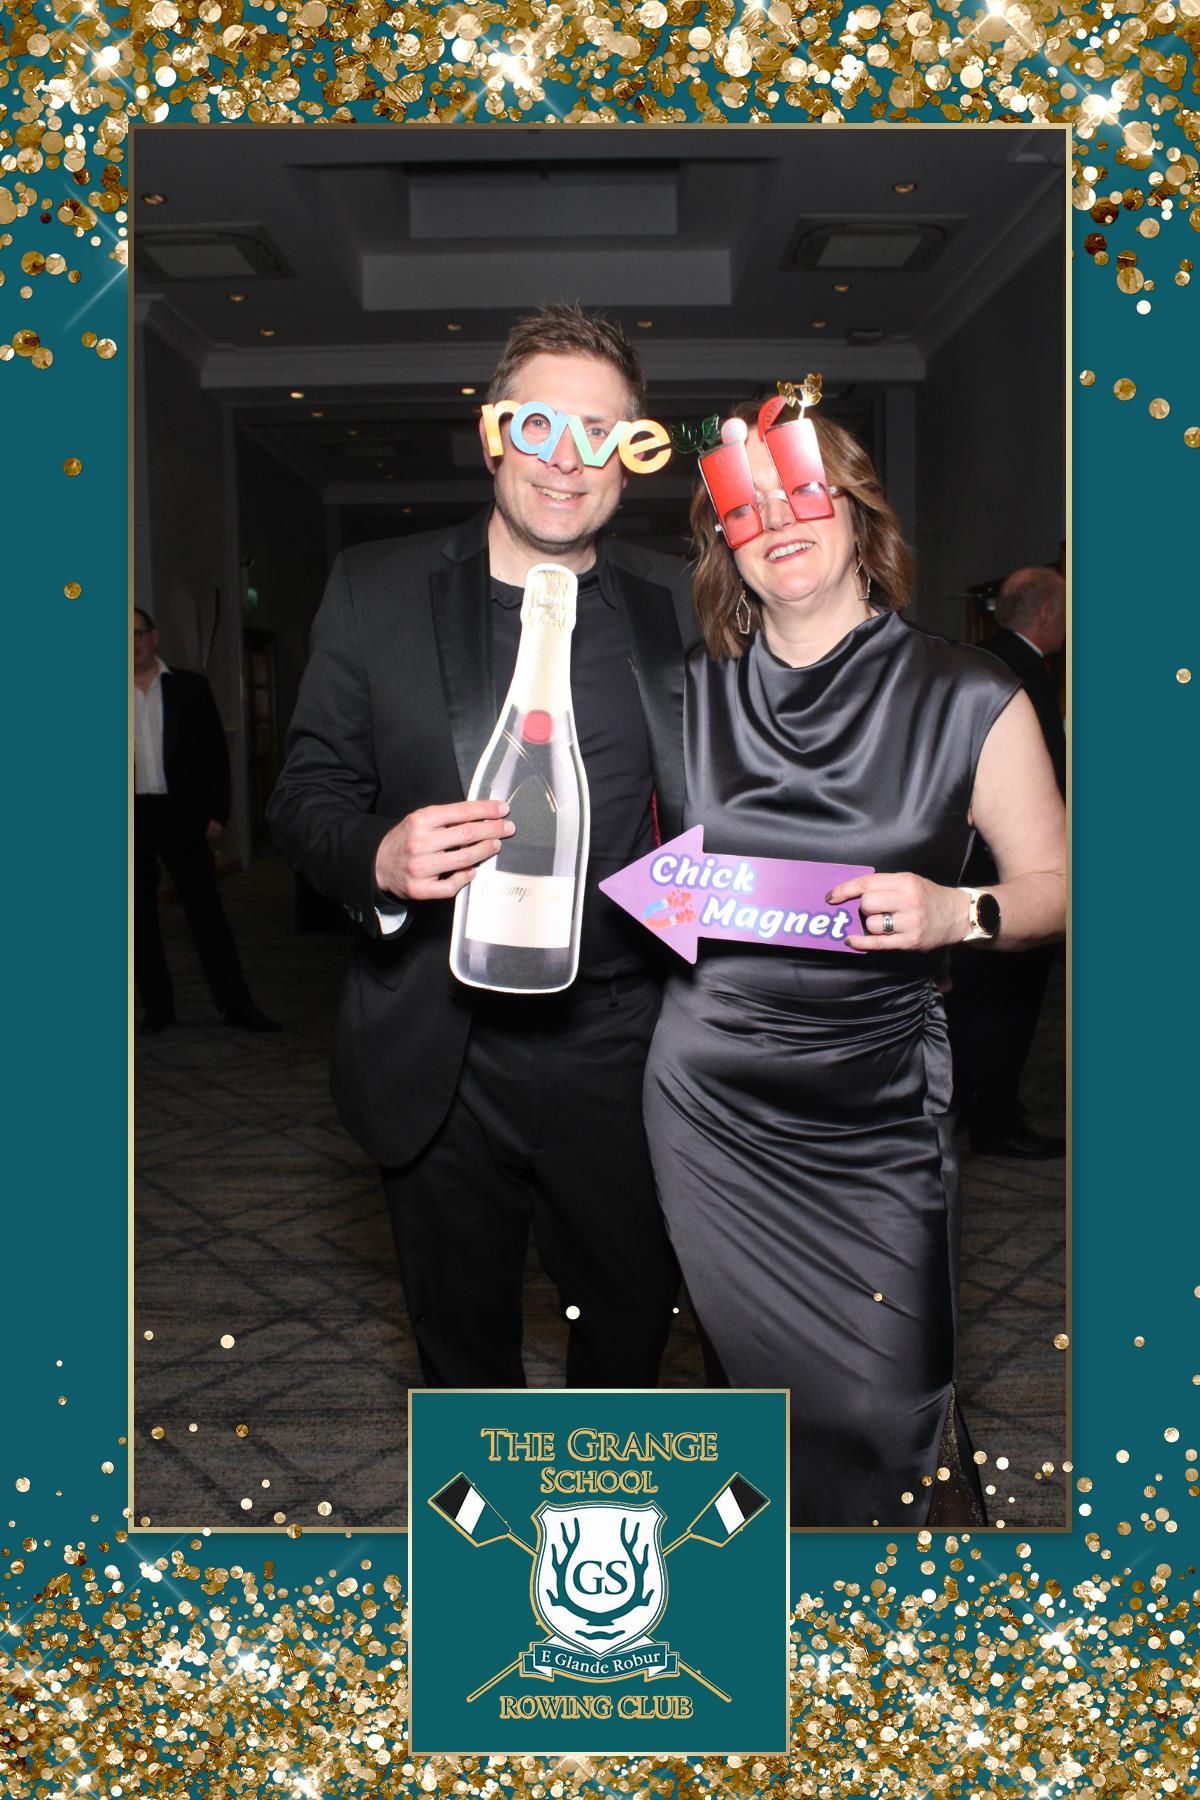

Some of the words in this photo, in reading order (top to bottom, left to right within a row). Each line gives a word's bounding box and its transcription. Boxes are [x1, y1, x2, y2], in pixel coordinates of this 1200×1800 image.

[480, 400, 673, 475] rave
[651, 855, 755, 893] Chick
[700, 897, 850, 940] Magnet
